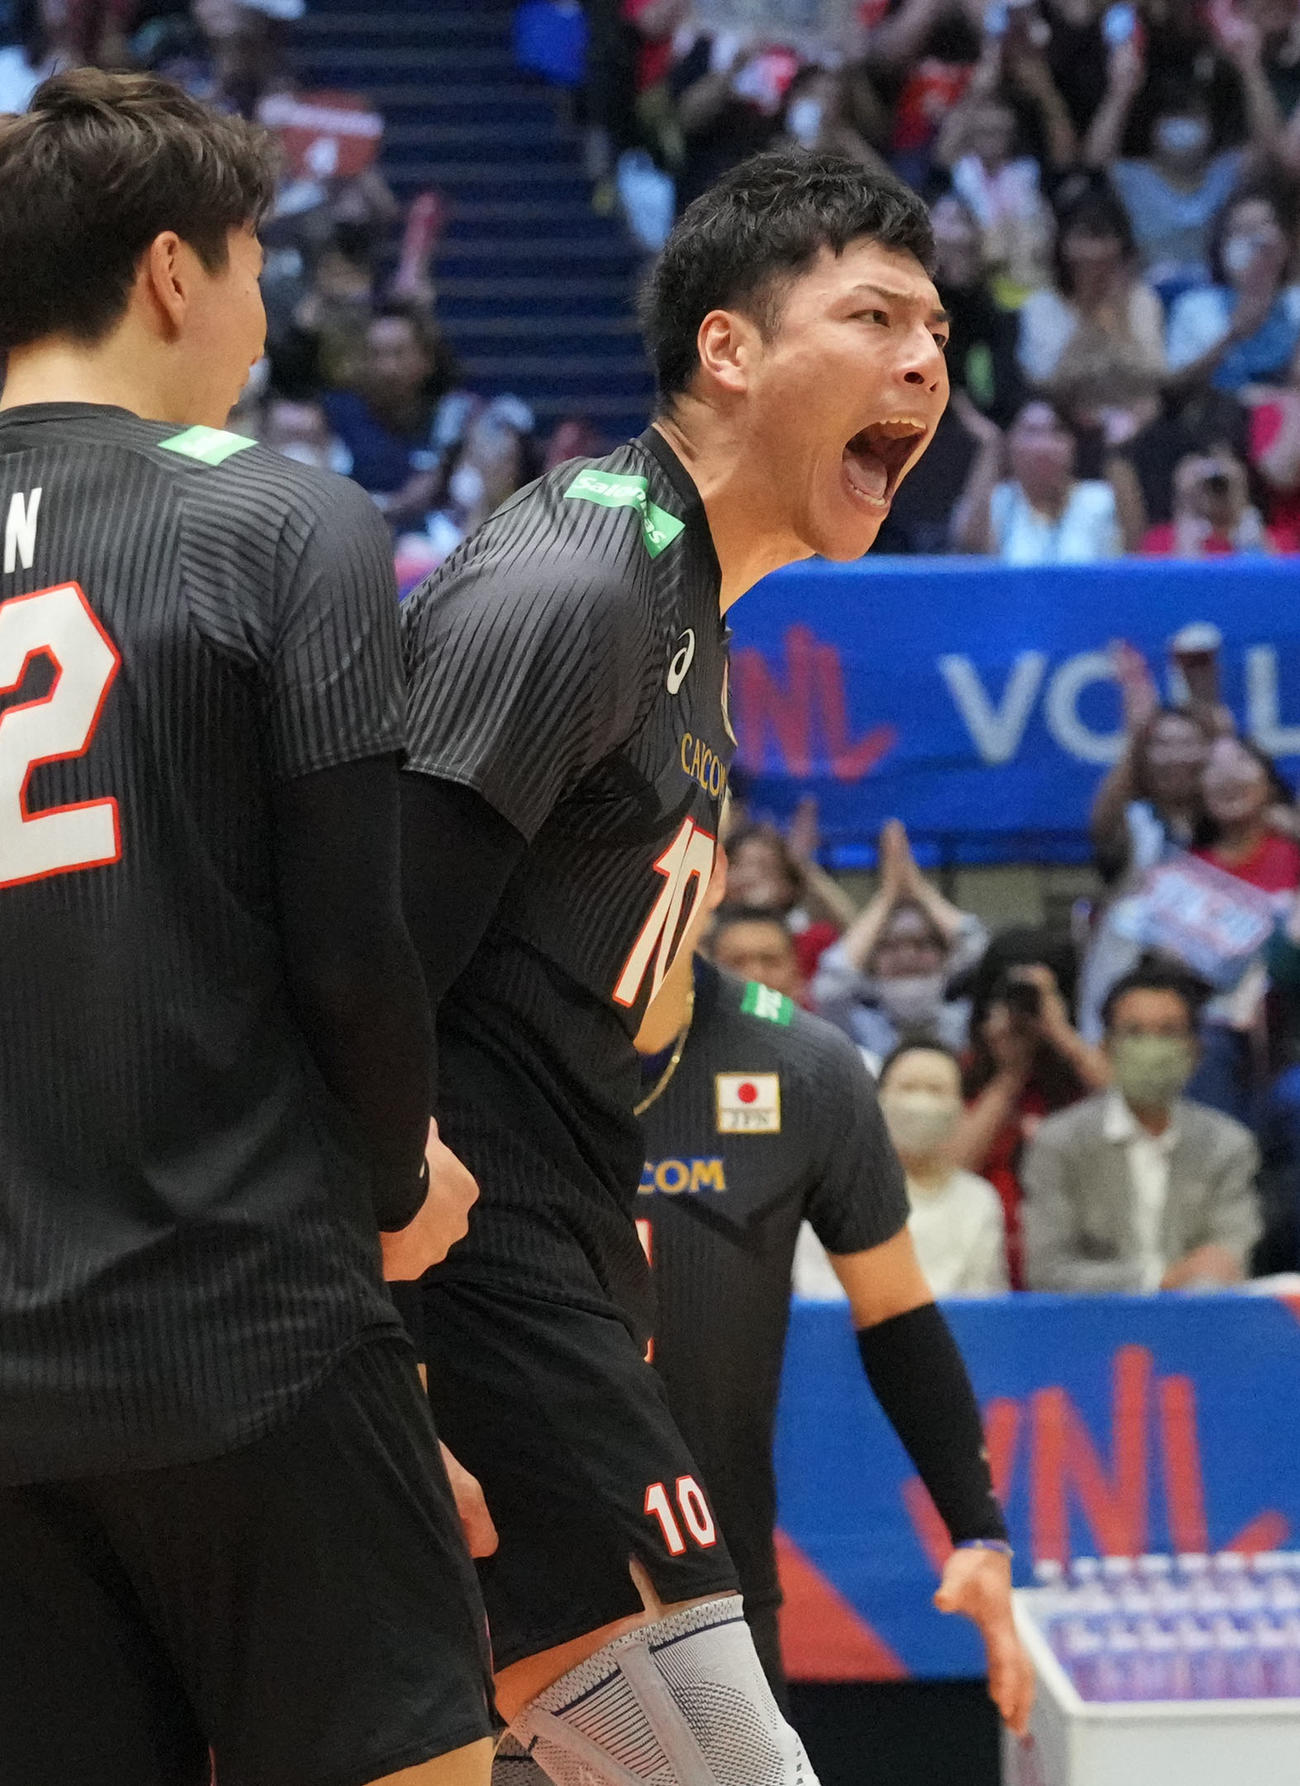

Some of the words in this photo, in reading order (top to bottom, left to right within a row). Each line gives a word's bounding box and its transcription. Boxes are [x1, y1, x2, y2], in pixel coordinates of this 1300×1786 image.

[4, 487, 43, 574] N
[0, 581, 122, 889] 2
[612, 815, 717, 1008] 10
[644, 1474, 718, 1557] 10
